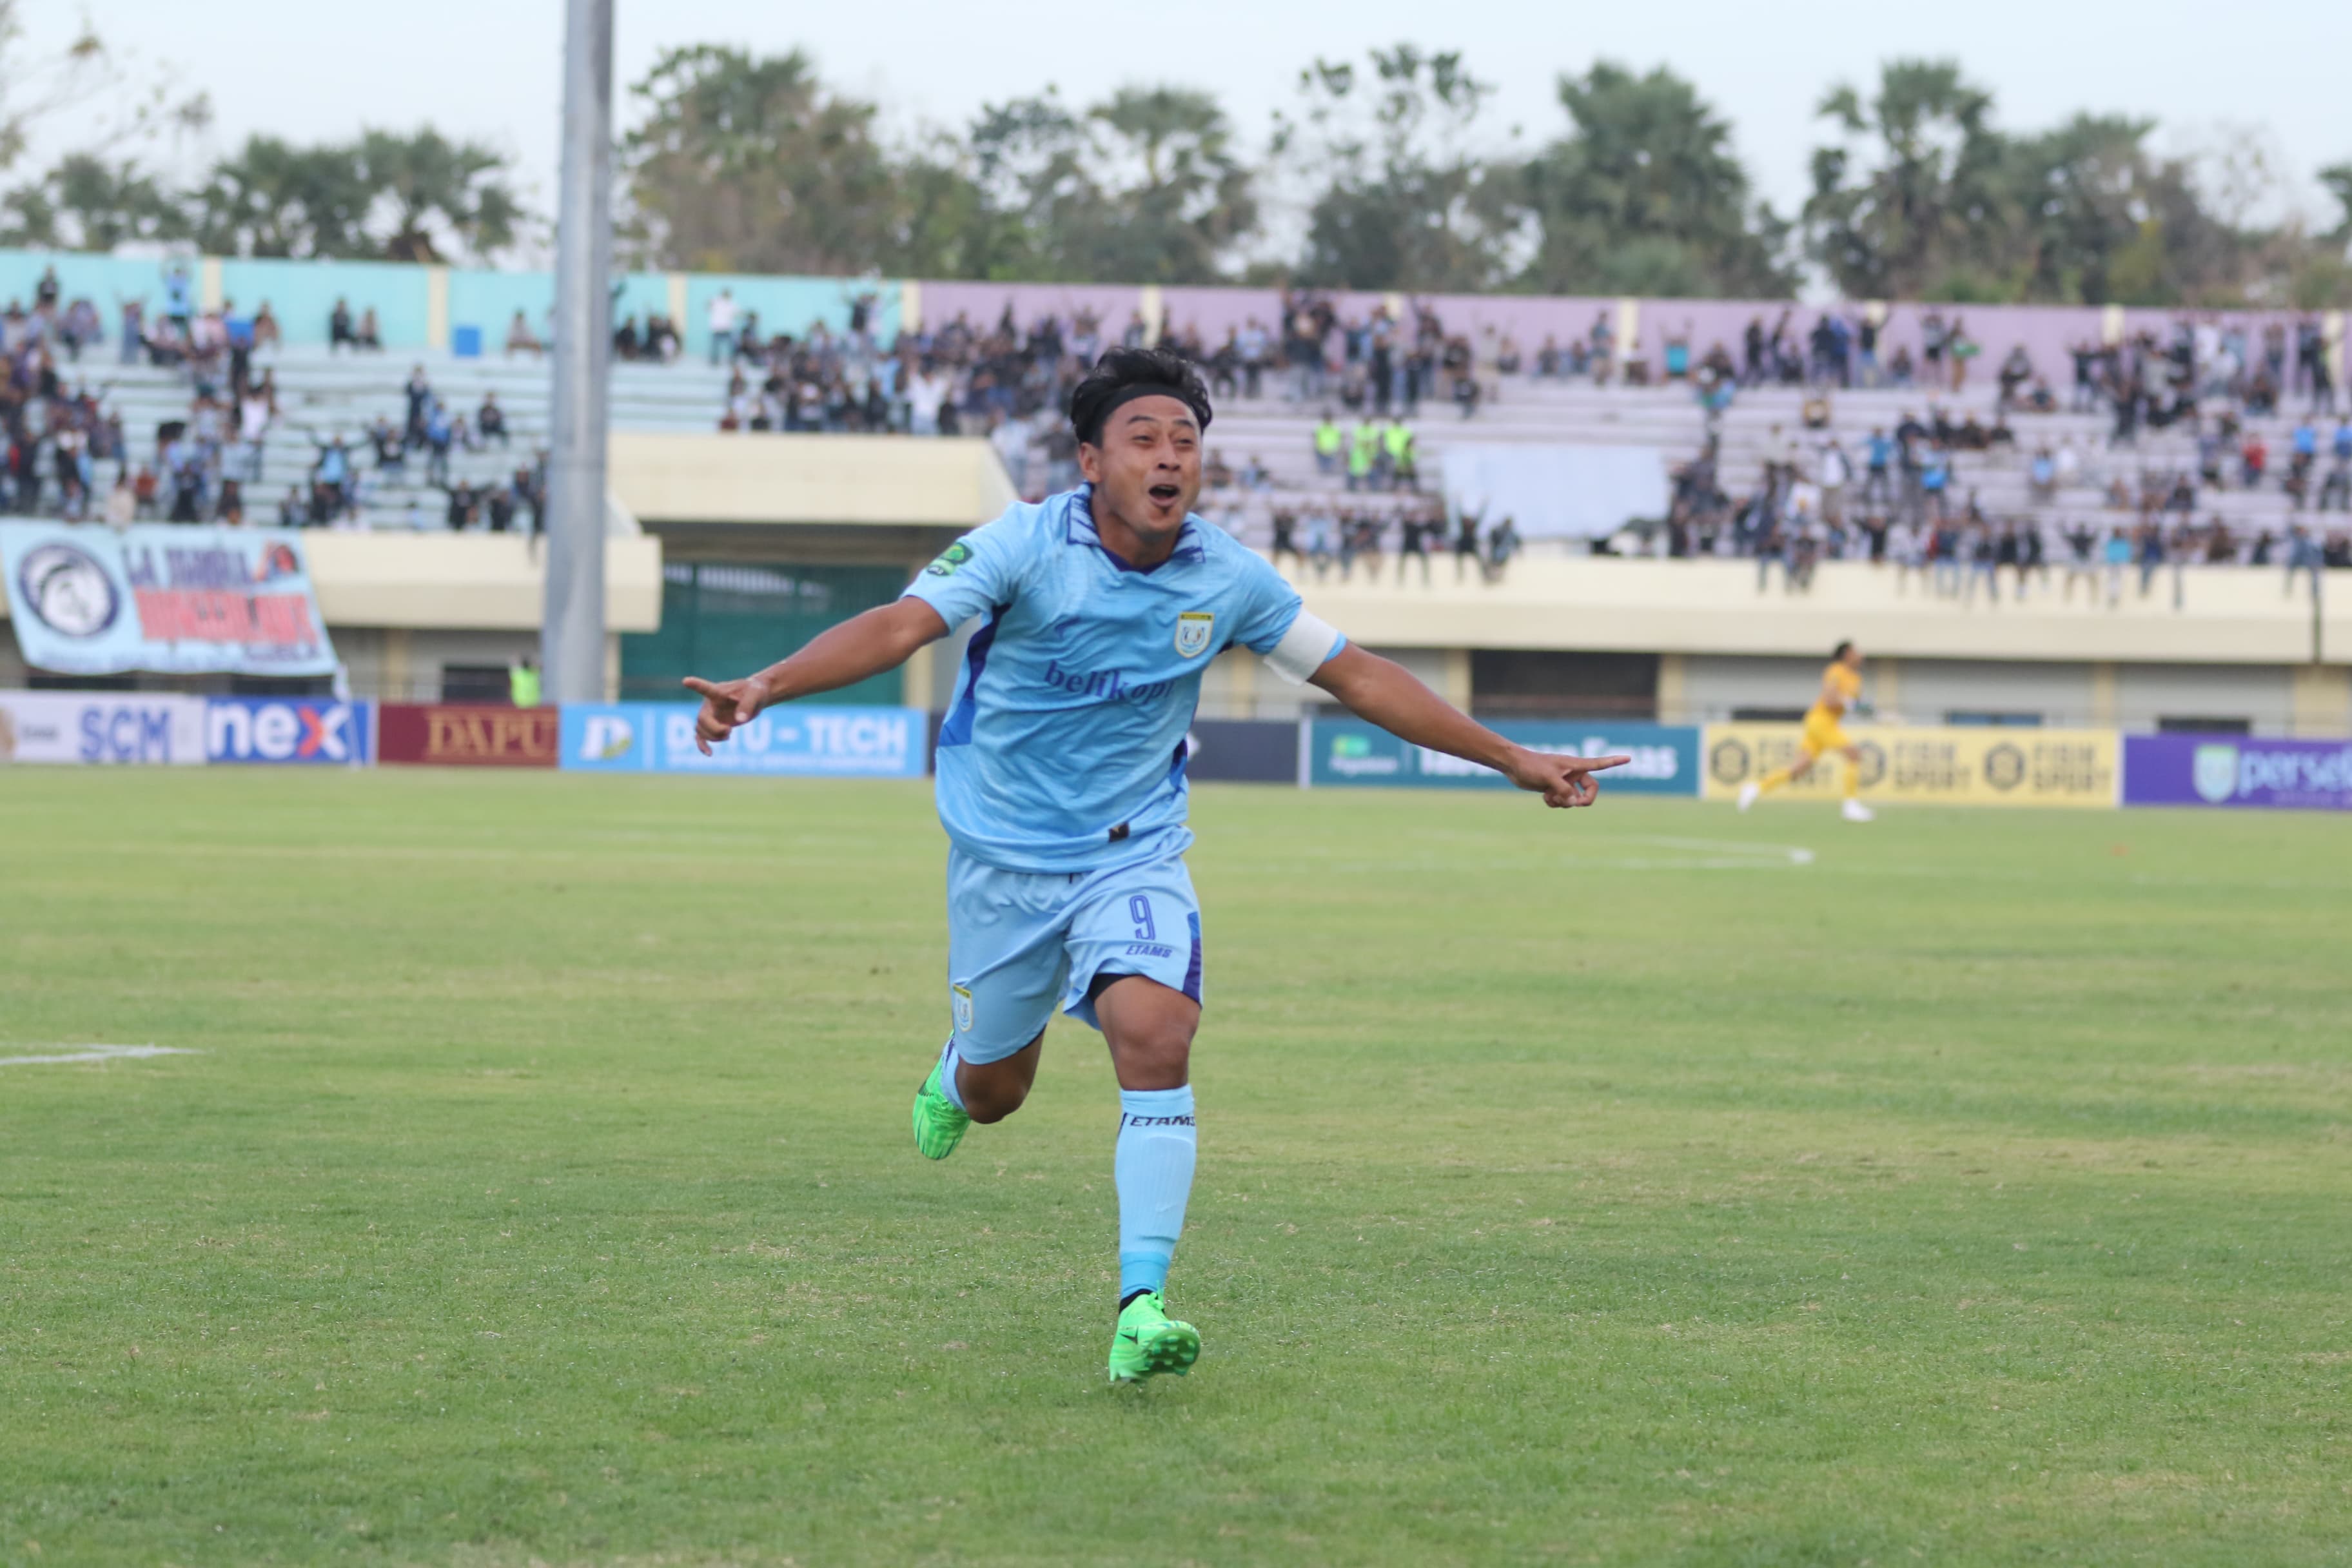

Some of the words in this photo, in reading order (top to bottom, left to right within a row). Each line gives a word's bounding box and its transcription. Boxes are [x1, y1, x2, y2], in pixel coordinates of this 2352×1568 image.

[79, 707, 172, 763] SCM
[210, 703, 350, 760] nex
[665, 714, 772, 752] DU
[805, 715, 908, 754] TECH
[1128, 894, 1155, 941] 9
[1125, 944, 1173, 959] ETAMS
